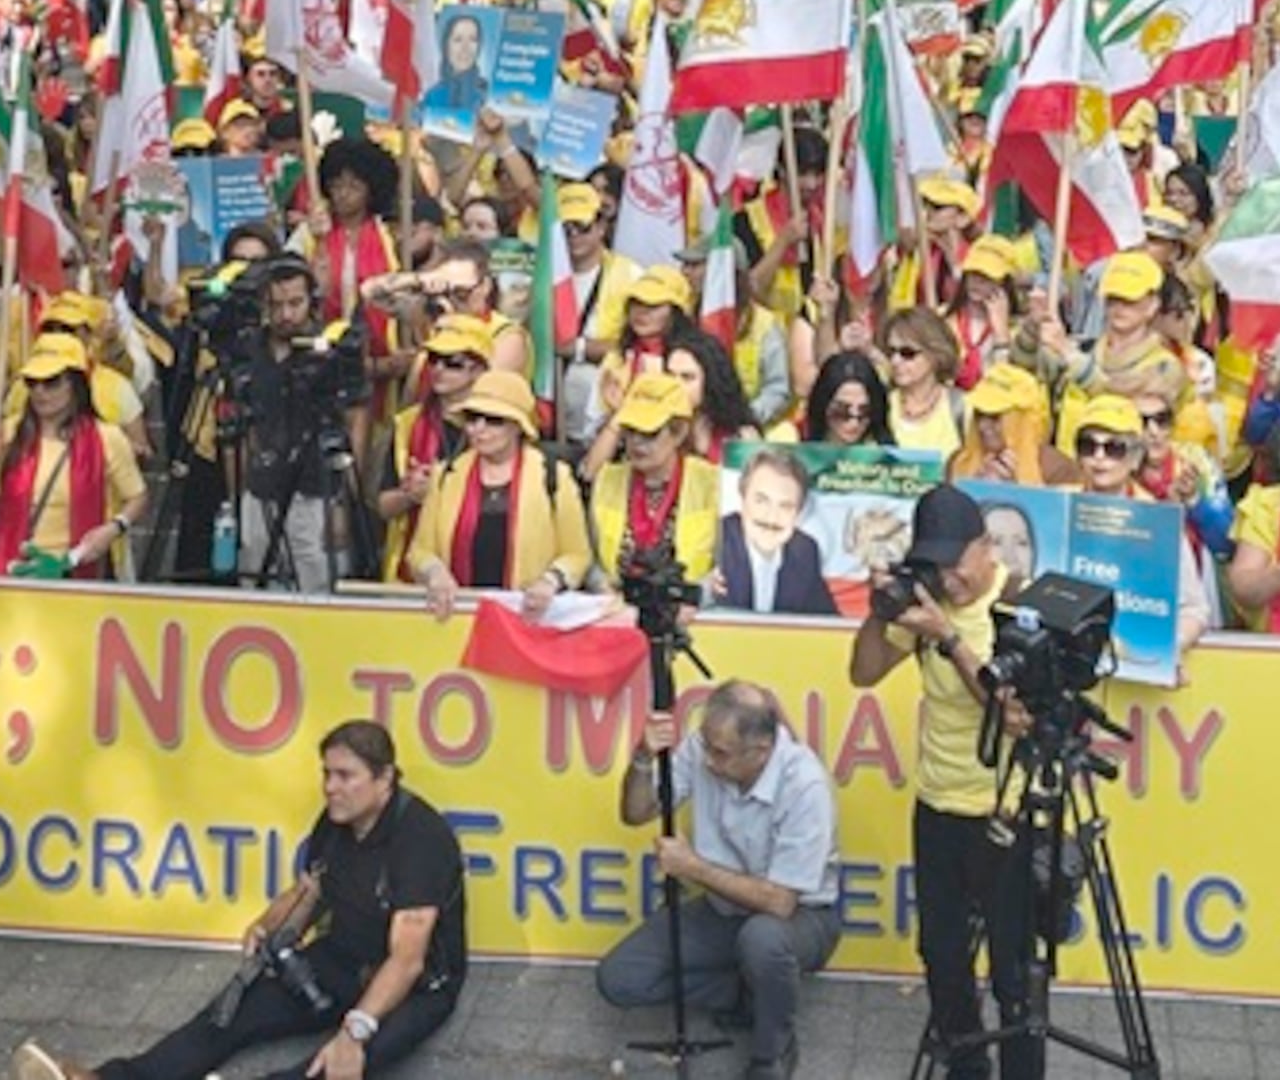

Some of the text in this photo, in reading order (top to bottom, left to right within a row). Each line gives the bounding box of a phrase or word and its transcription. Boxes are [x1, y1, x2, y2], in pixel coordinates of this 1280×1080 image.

[1072, 555, 1121, 582] Free
[93, 616, 303, 753] NO
[351, 668, 493, 766] TO
